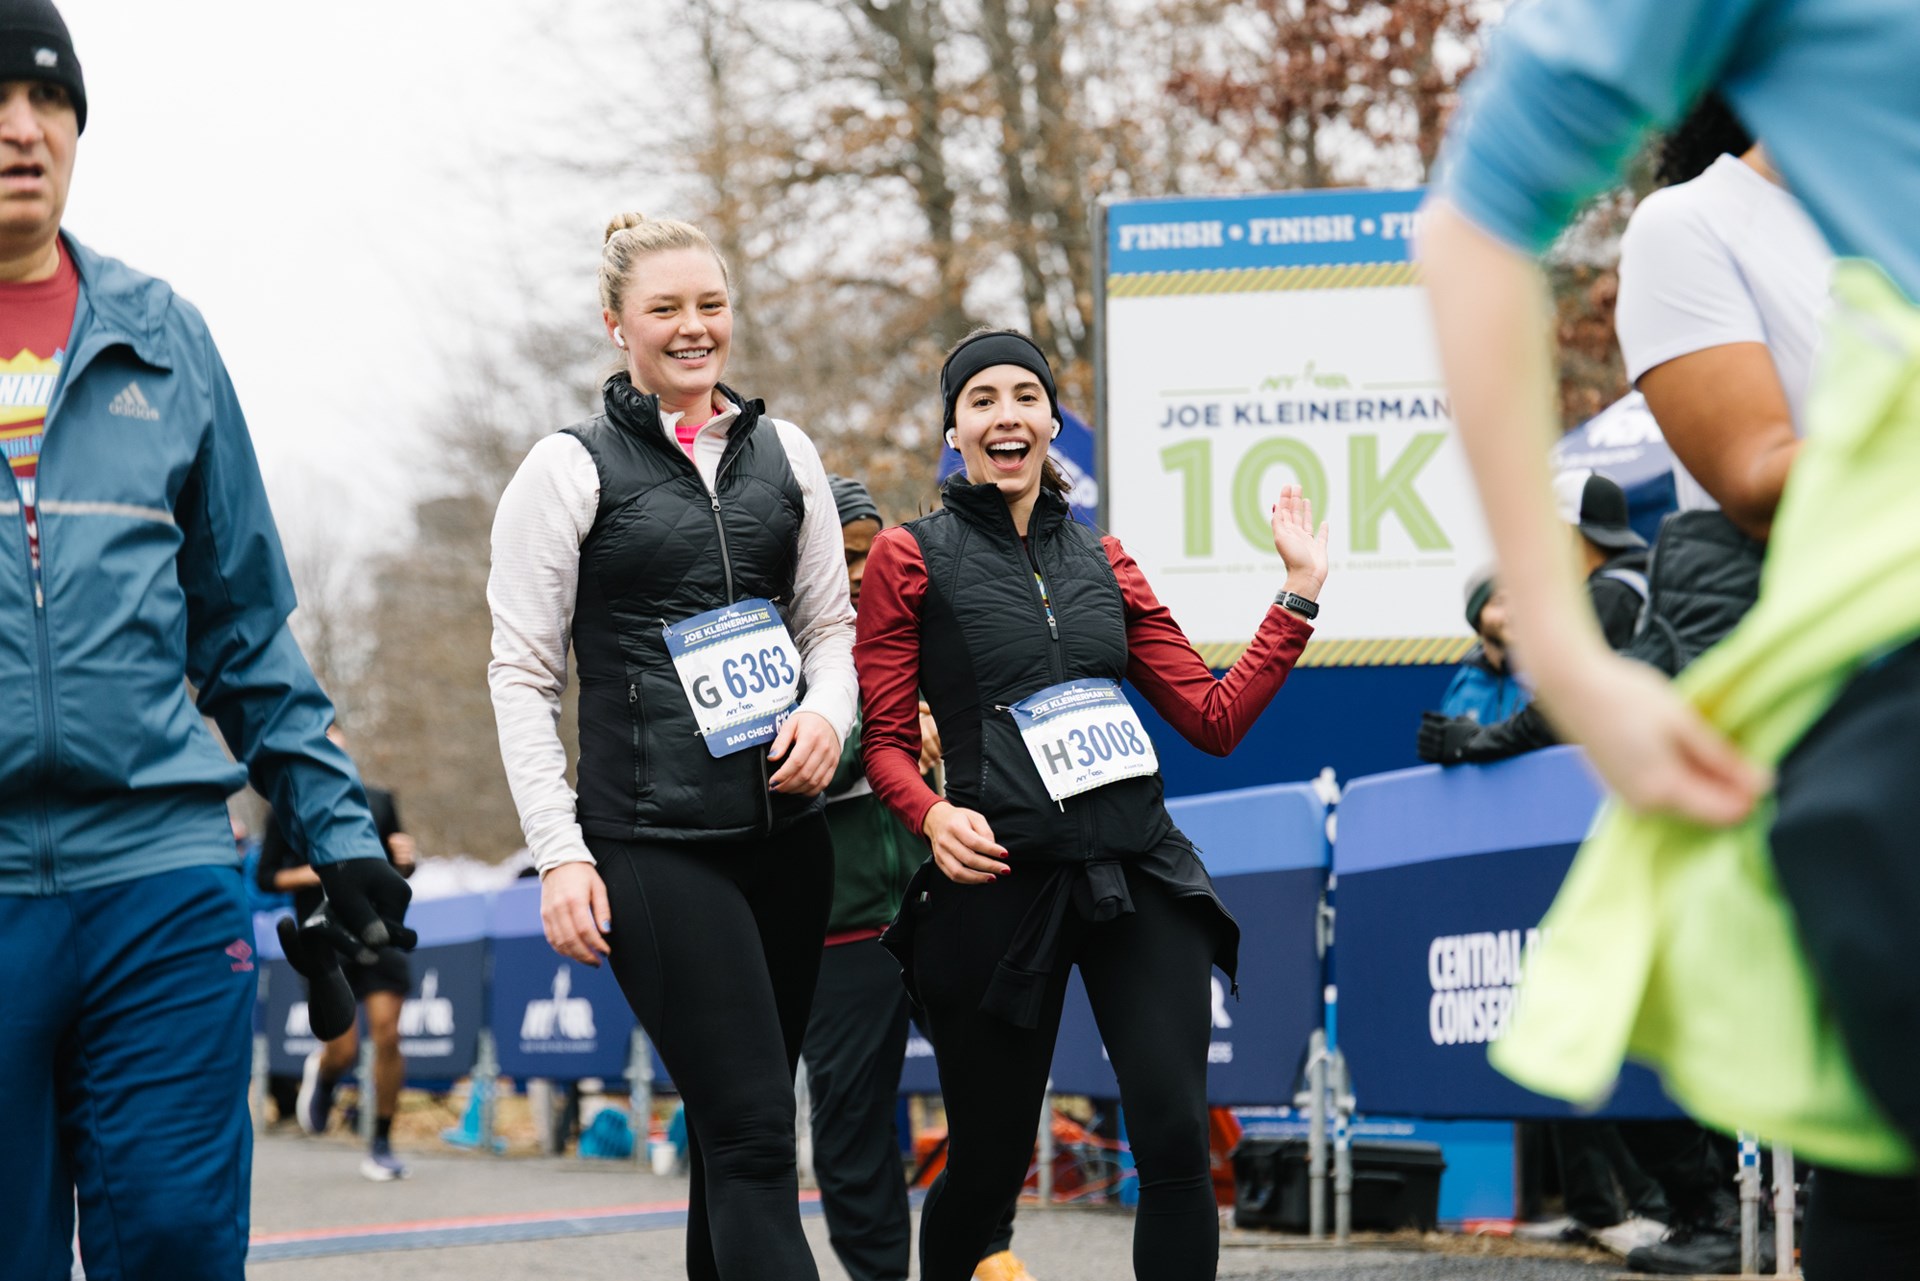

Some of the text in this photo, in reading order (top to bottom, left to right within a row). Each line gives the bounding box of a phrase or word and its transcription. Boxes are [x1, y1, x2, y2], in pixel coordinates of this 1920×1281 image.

[1118, 220, 1224, 251] FINISH
[1248, 214, 1356, 246] FINISH
[108, 399, 160, 421] adidas
[1159, 397, 1451, 429] JOE KLEINERMAN
[1159, 431, 1454, 558] 10K
[684, 631, 703, 645] JOE
[703, 614, 759, 639] KLEINERMAN
[757, 611, 771, 621] 10K
[692, 645, 795, 709] G 6363
[1031, 703, 1050, 718] JOE
[1049, 691, 1104, 709] KLEINERMAN
[726, 724, 774, 746] BAG CHECK
[1041, 720, 1146, 775] H 3008
[1428, 928, 1523, 991] CENTRAL
[1429, 985, 1519, 1046] CONSER
